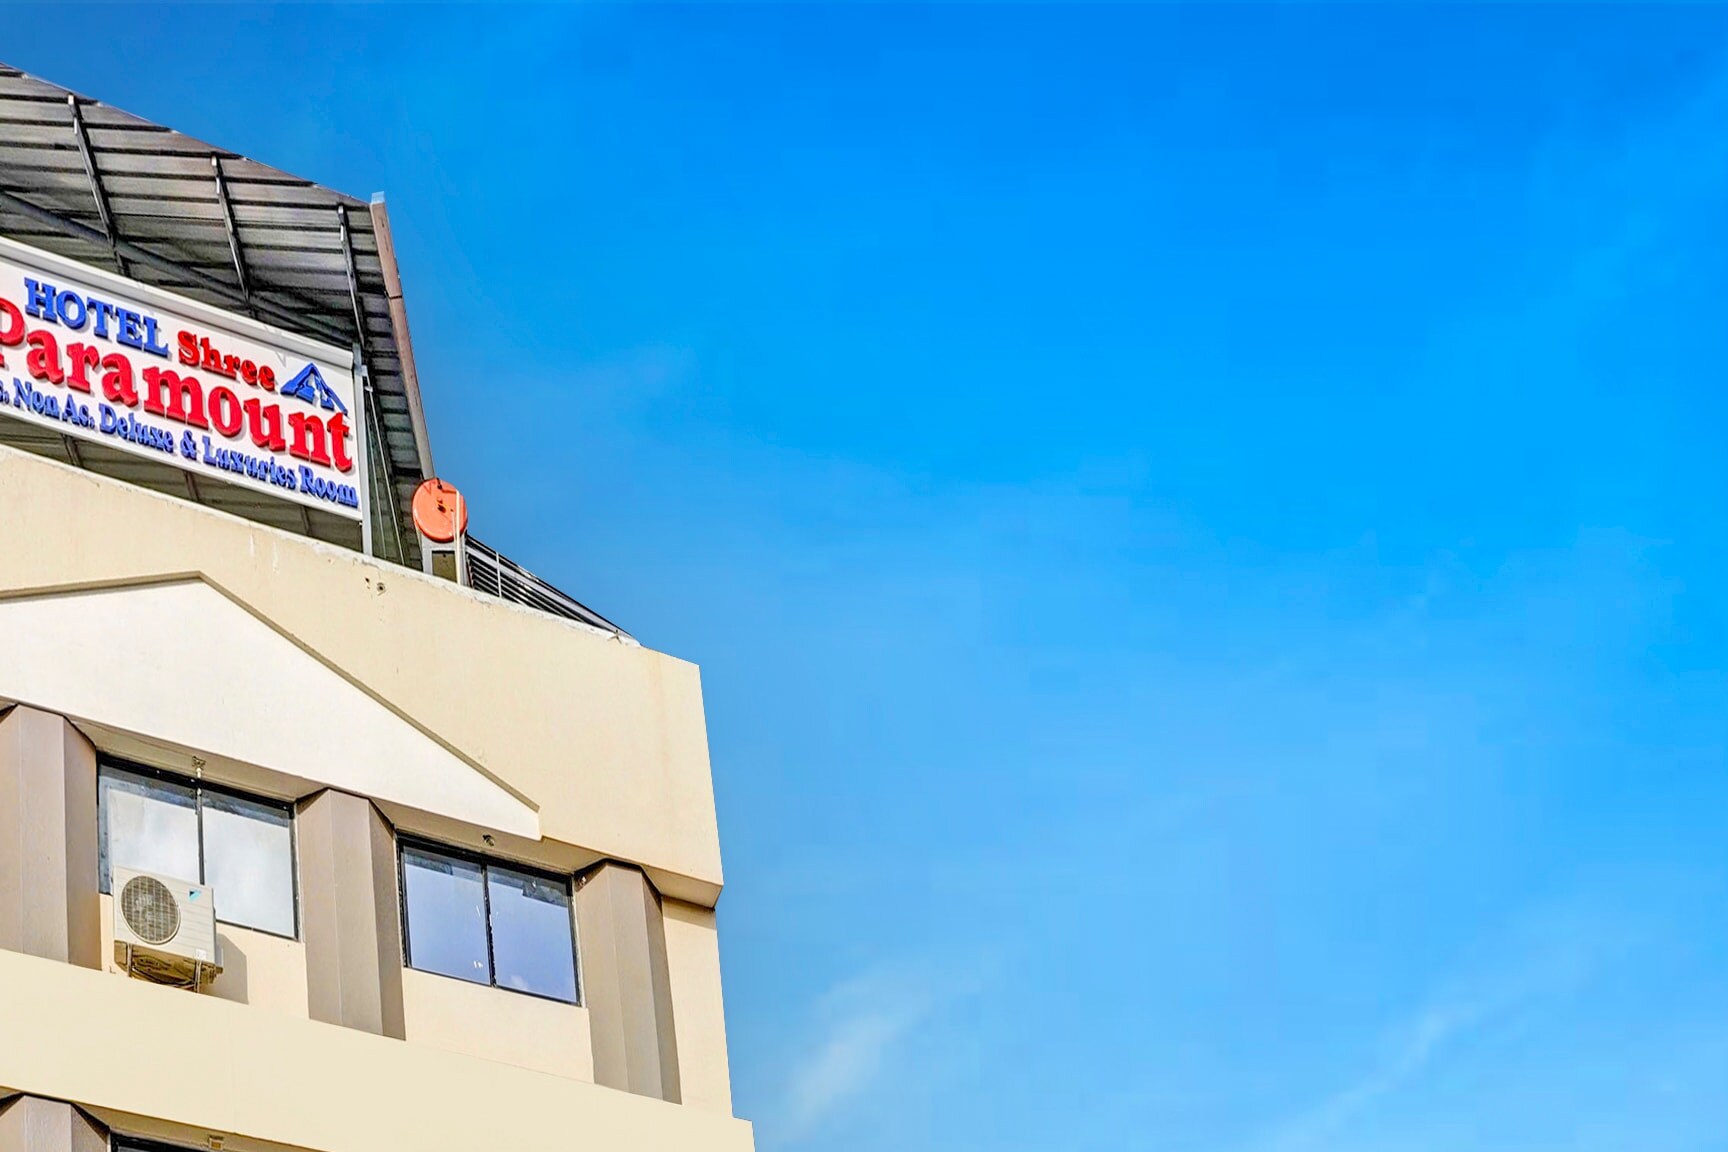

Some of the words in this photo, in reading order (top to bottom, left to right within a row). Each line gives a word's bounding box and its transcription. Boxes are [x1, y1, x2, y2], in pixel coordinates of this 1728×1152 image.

[24, 277, 169, 358] HOTEL
[177, 329, 276, 392] Shree
[13, 377, 61, 420] Non
[99, 402, 174, 454] Deluxe
[180, 430, 197, 461] &
[202, 435, 297, 490] Luxuries
[298, 465, 359, 509] Room
